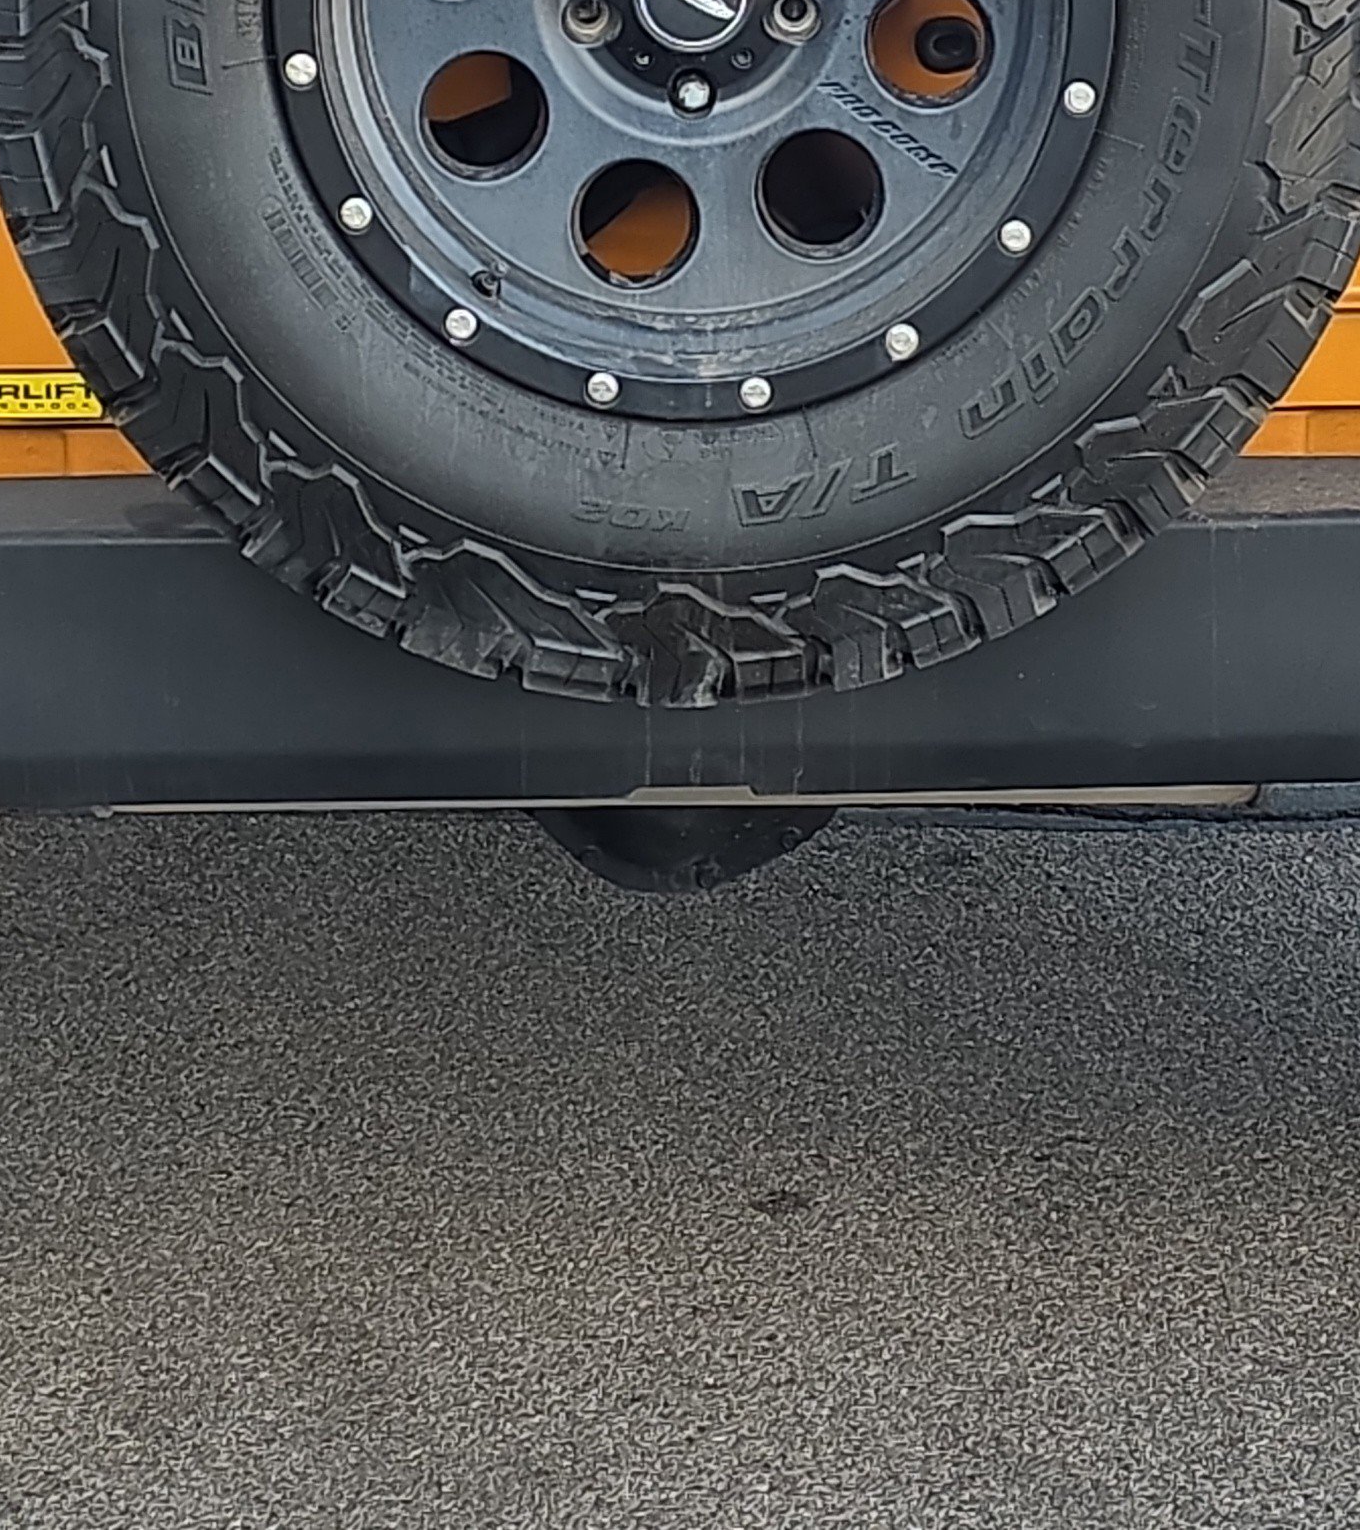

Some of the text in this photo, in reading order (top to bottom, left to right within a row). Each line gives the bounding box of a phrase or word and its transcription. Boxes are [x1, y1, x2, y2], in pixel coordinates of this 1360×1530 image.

[816, 81, 959, 178] PRO COMP
[571, 442, 917, 533] T/A KO2
